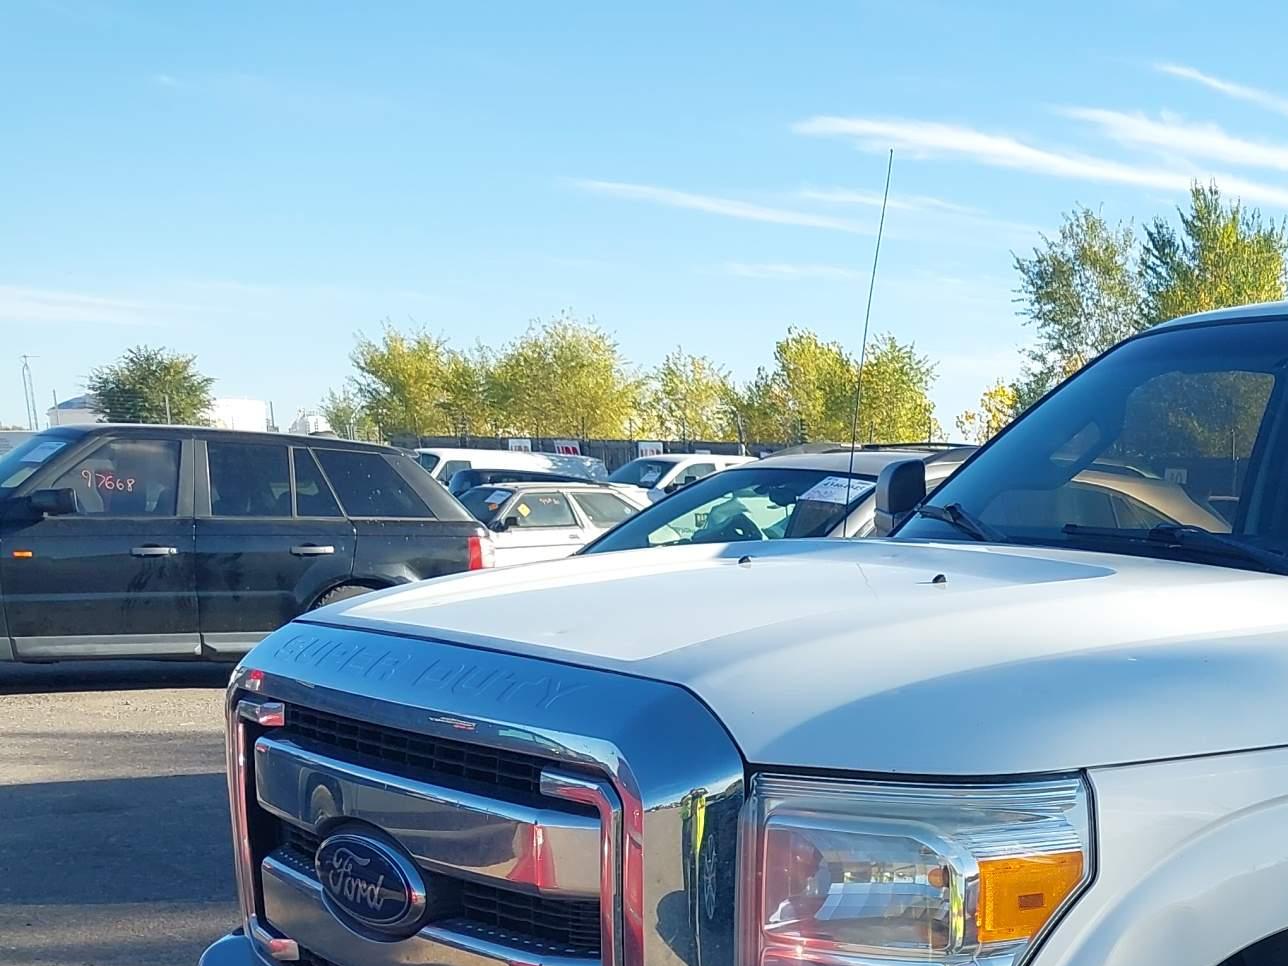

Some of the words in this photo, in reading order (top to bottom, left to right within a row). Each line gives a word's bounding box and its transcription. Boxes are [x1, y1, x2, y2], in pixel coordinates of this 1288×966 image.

[82, 469, 135, 492] 97668
[273, 634, 412, 681] SUPER
[412, 657, 588, 709] DUTY
[328, 847, 385, 911] Ford
